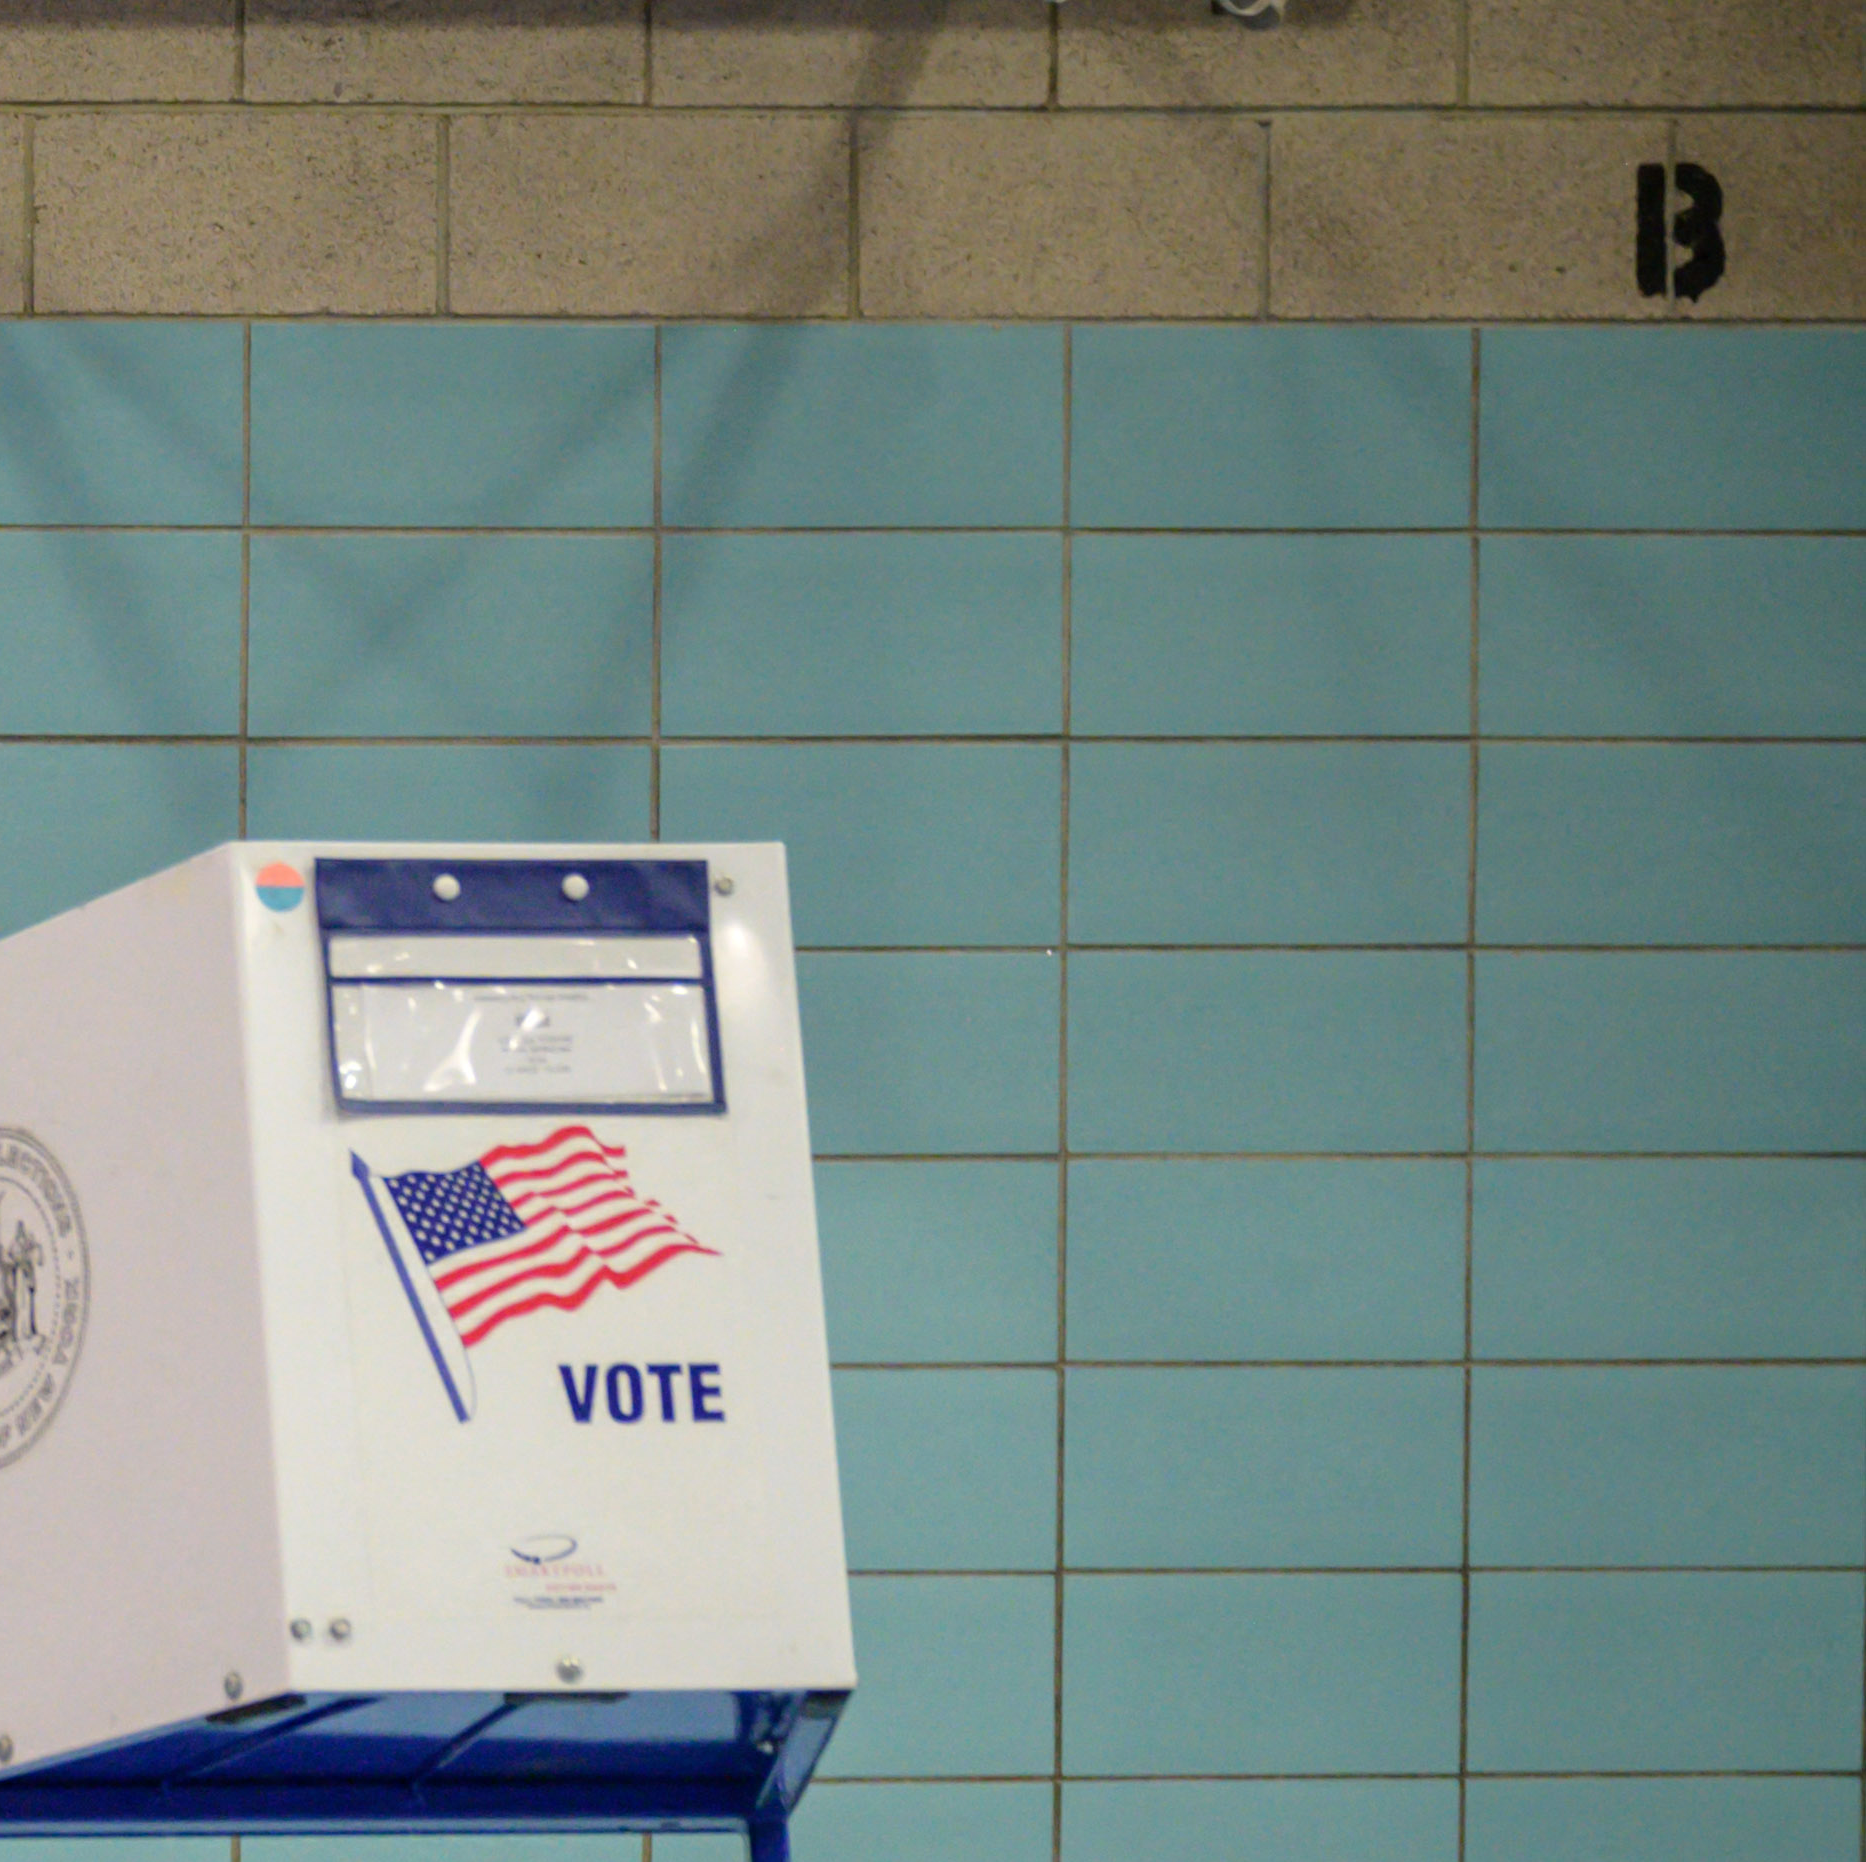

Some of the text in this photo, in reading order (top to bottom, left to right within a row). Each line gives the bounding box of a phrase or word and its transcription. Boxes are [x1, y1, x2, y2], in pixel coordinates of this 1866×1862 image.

[1637, 162, 1727, 303] B
[16, 1372, 56, 1436] NEW
[52, 1278, 81, 1365] YORK
[558, 1361, 725, 1426] VOTE
